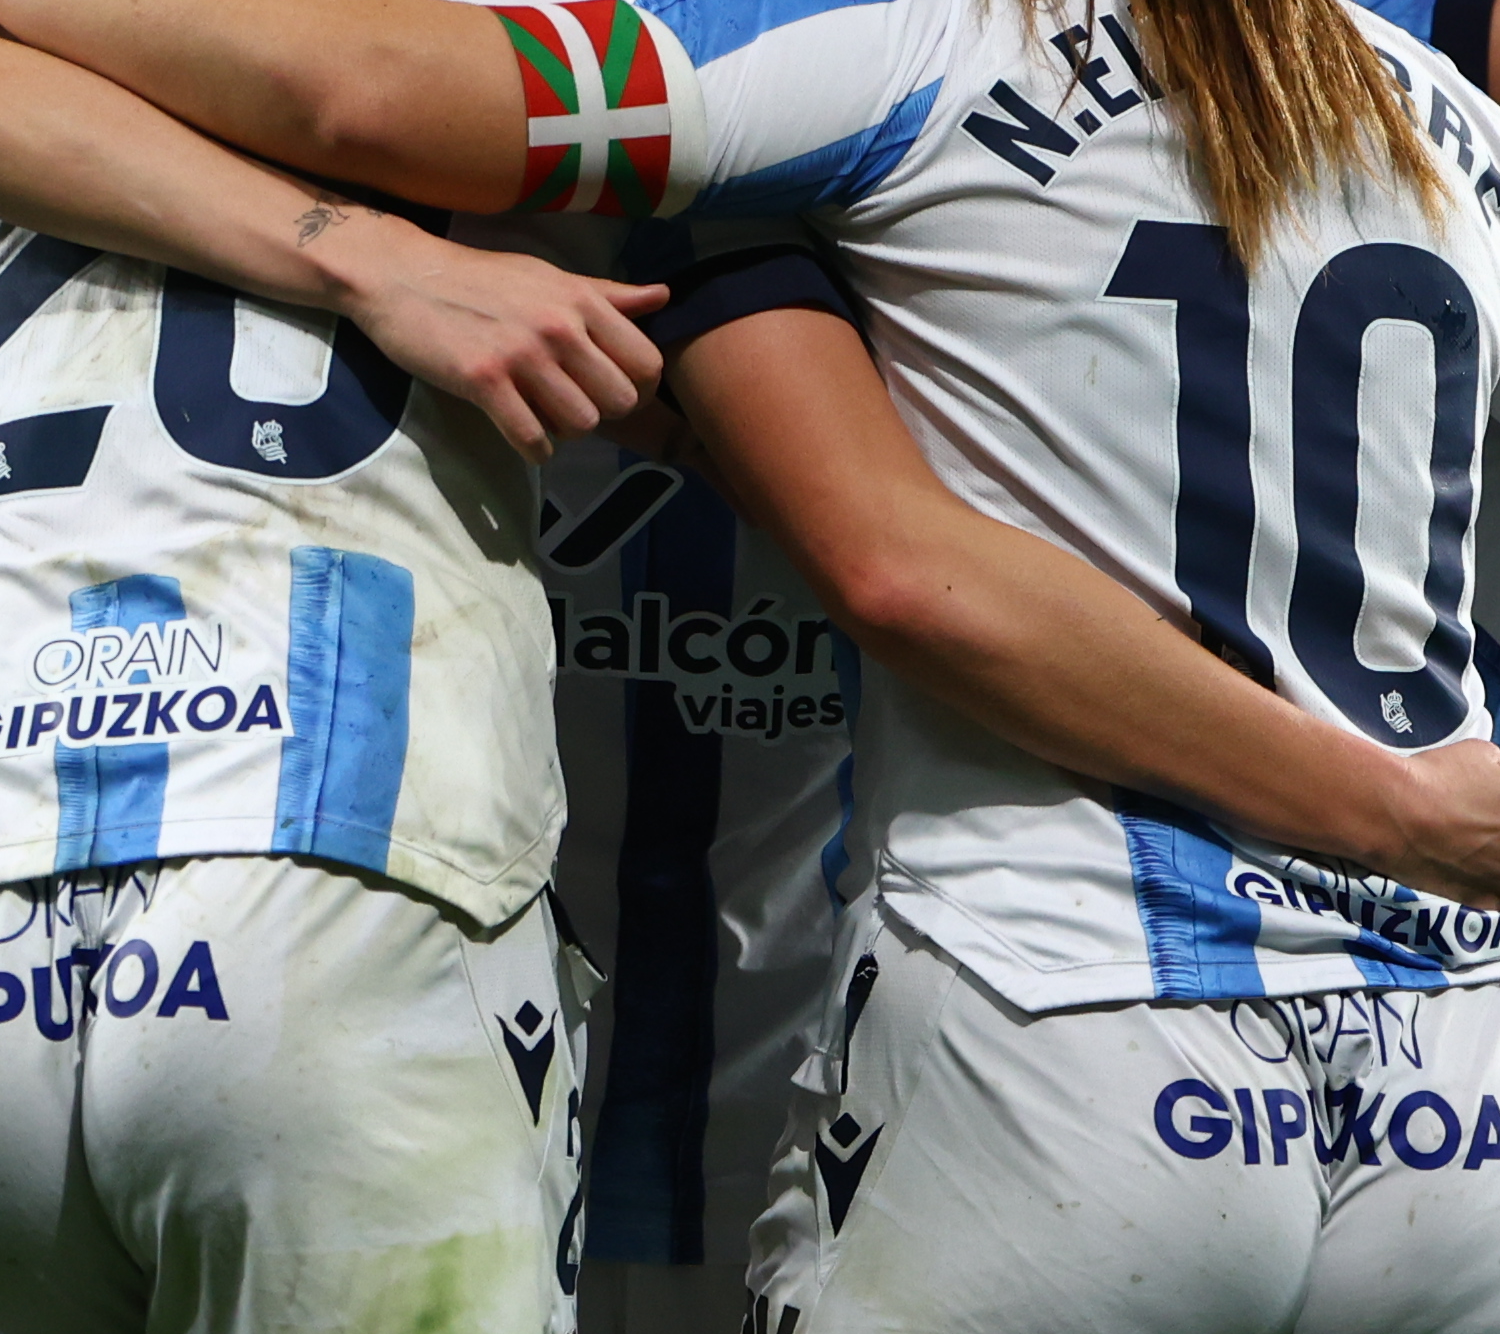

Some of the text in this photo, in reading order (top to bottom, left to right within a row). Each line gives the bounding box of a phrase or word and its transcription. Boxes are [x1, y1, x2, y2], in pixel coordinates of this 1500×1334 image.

[1100, 219, 1480, 749] 10
[33, 623, 222, 686] ORAIN
[551, 598, 838, 677] alcón
[682, 683, 845, 740] viajes
